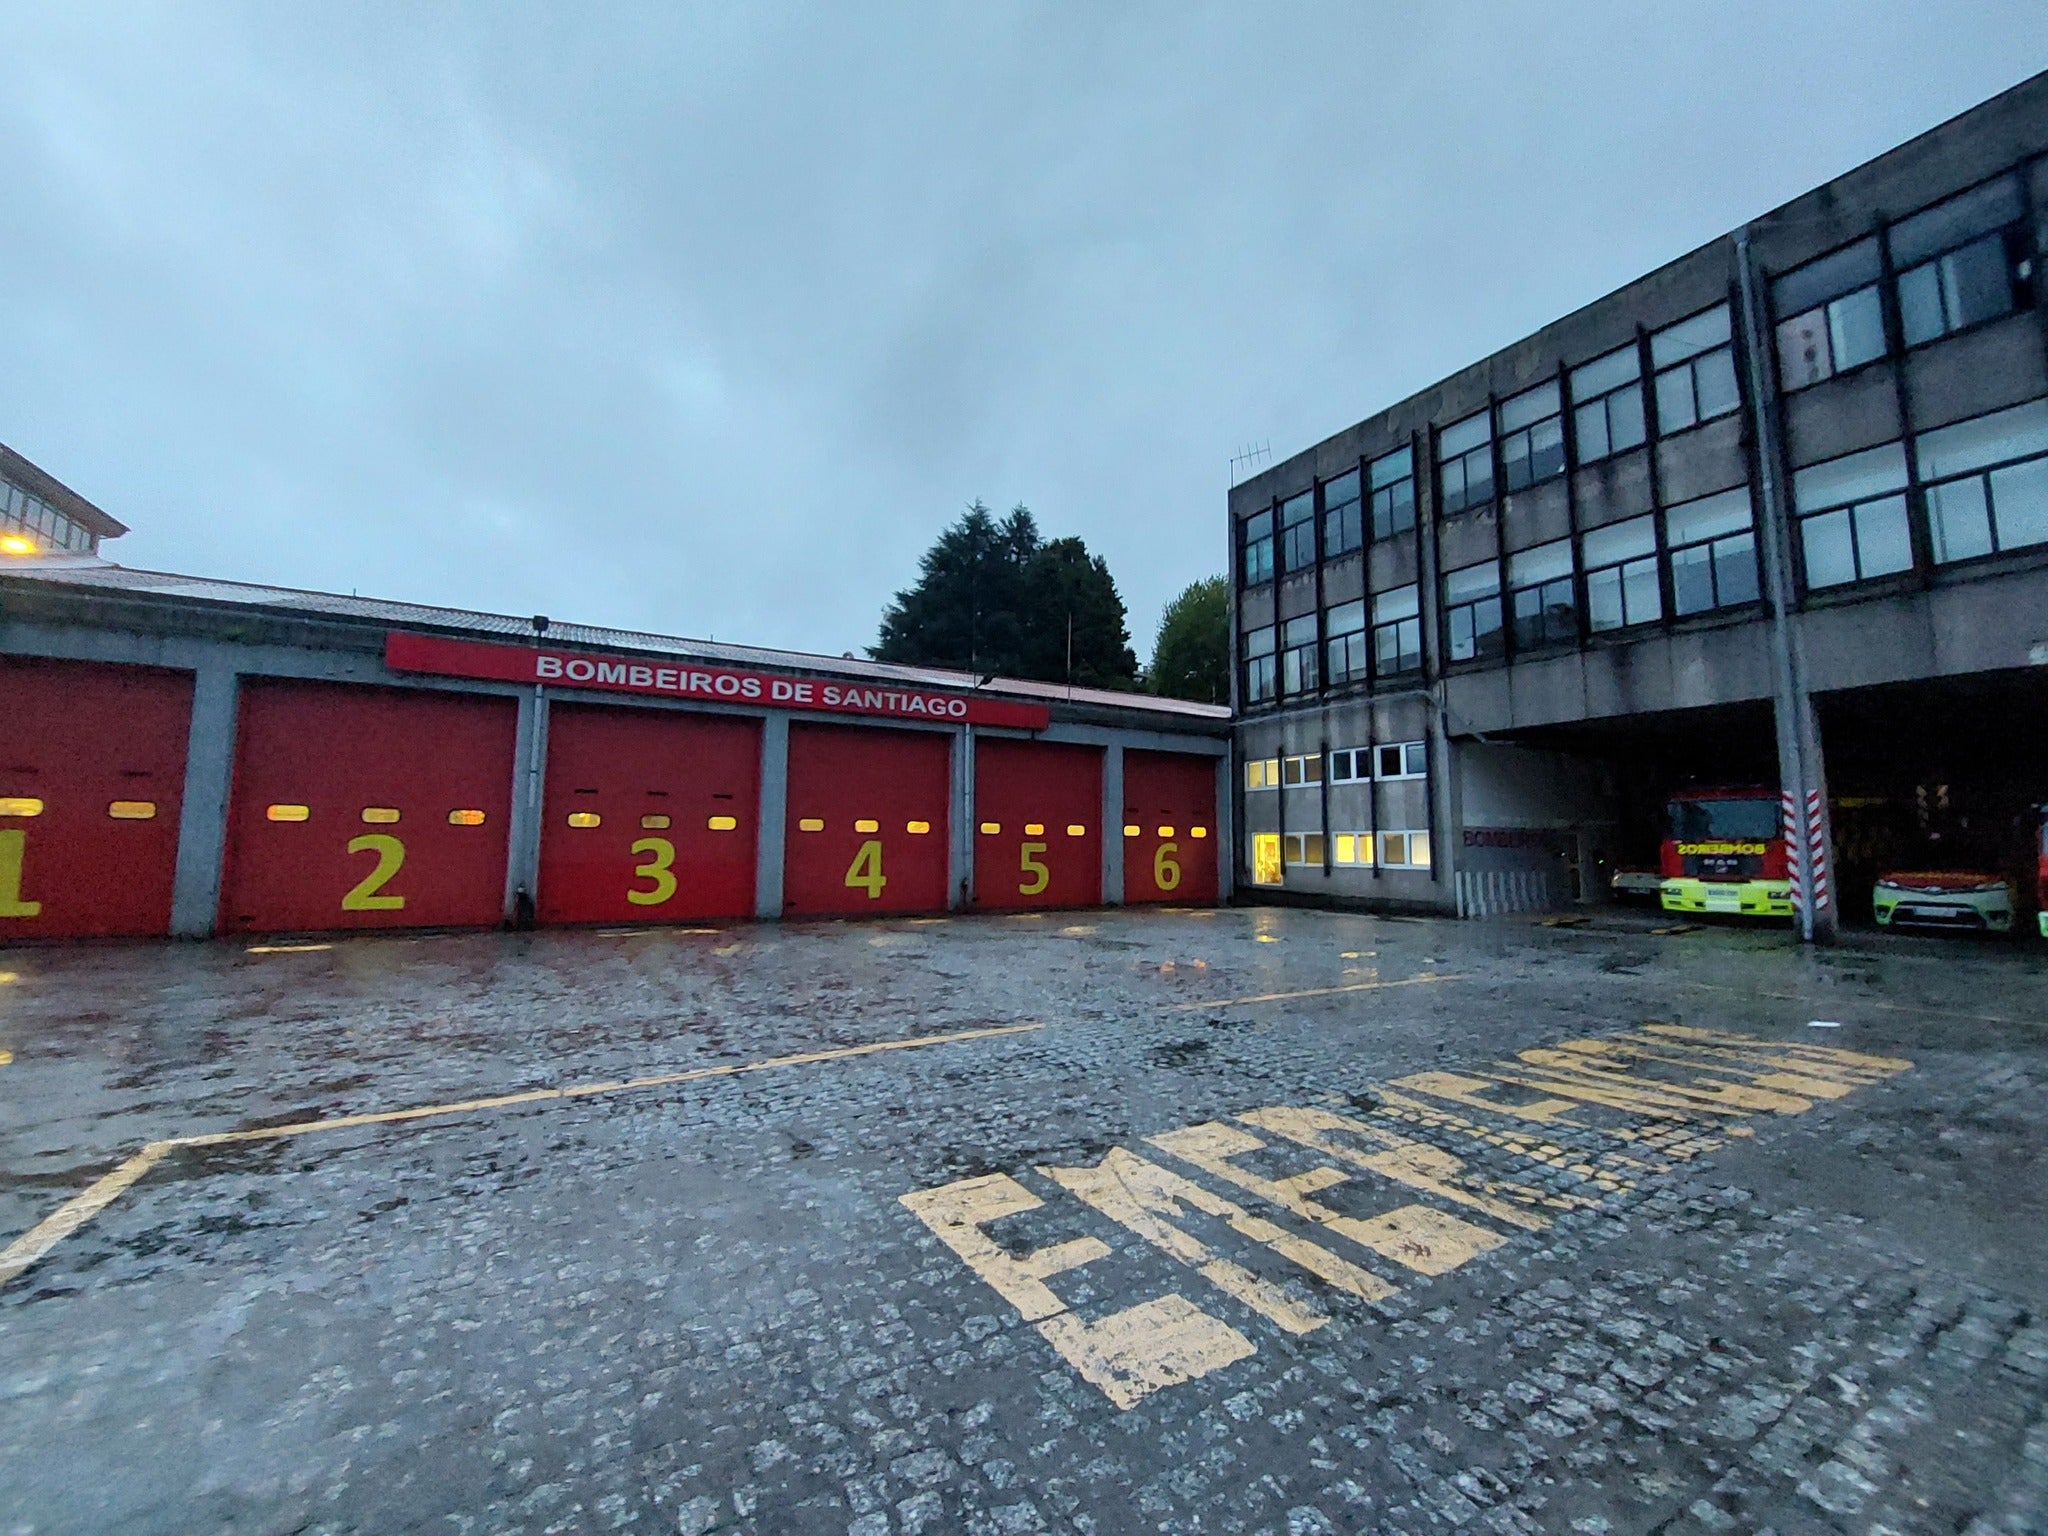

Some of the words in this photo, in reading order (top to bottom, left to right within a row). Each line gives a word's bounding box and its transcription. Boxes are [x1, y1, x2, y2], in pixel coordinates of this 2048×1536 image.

[536, 656, 761, 698] BOMBEIROS
[771, 681, 813, 702] DE
[822, 686, 968, 718] SANTIAGO
[341, 834, 405, 910] 2
[627, 838, 678, 905] 3
[844, 841, 887, 899] 4
[1018, 842, 1050, 894] 5
[1154, 842, 1181, 890] 6
